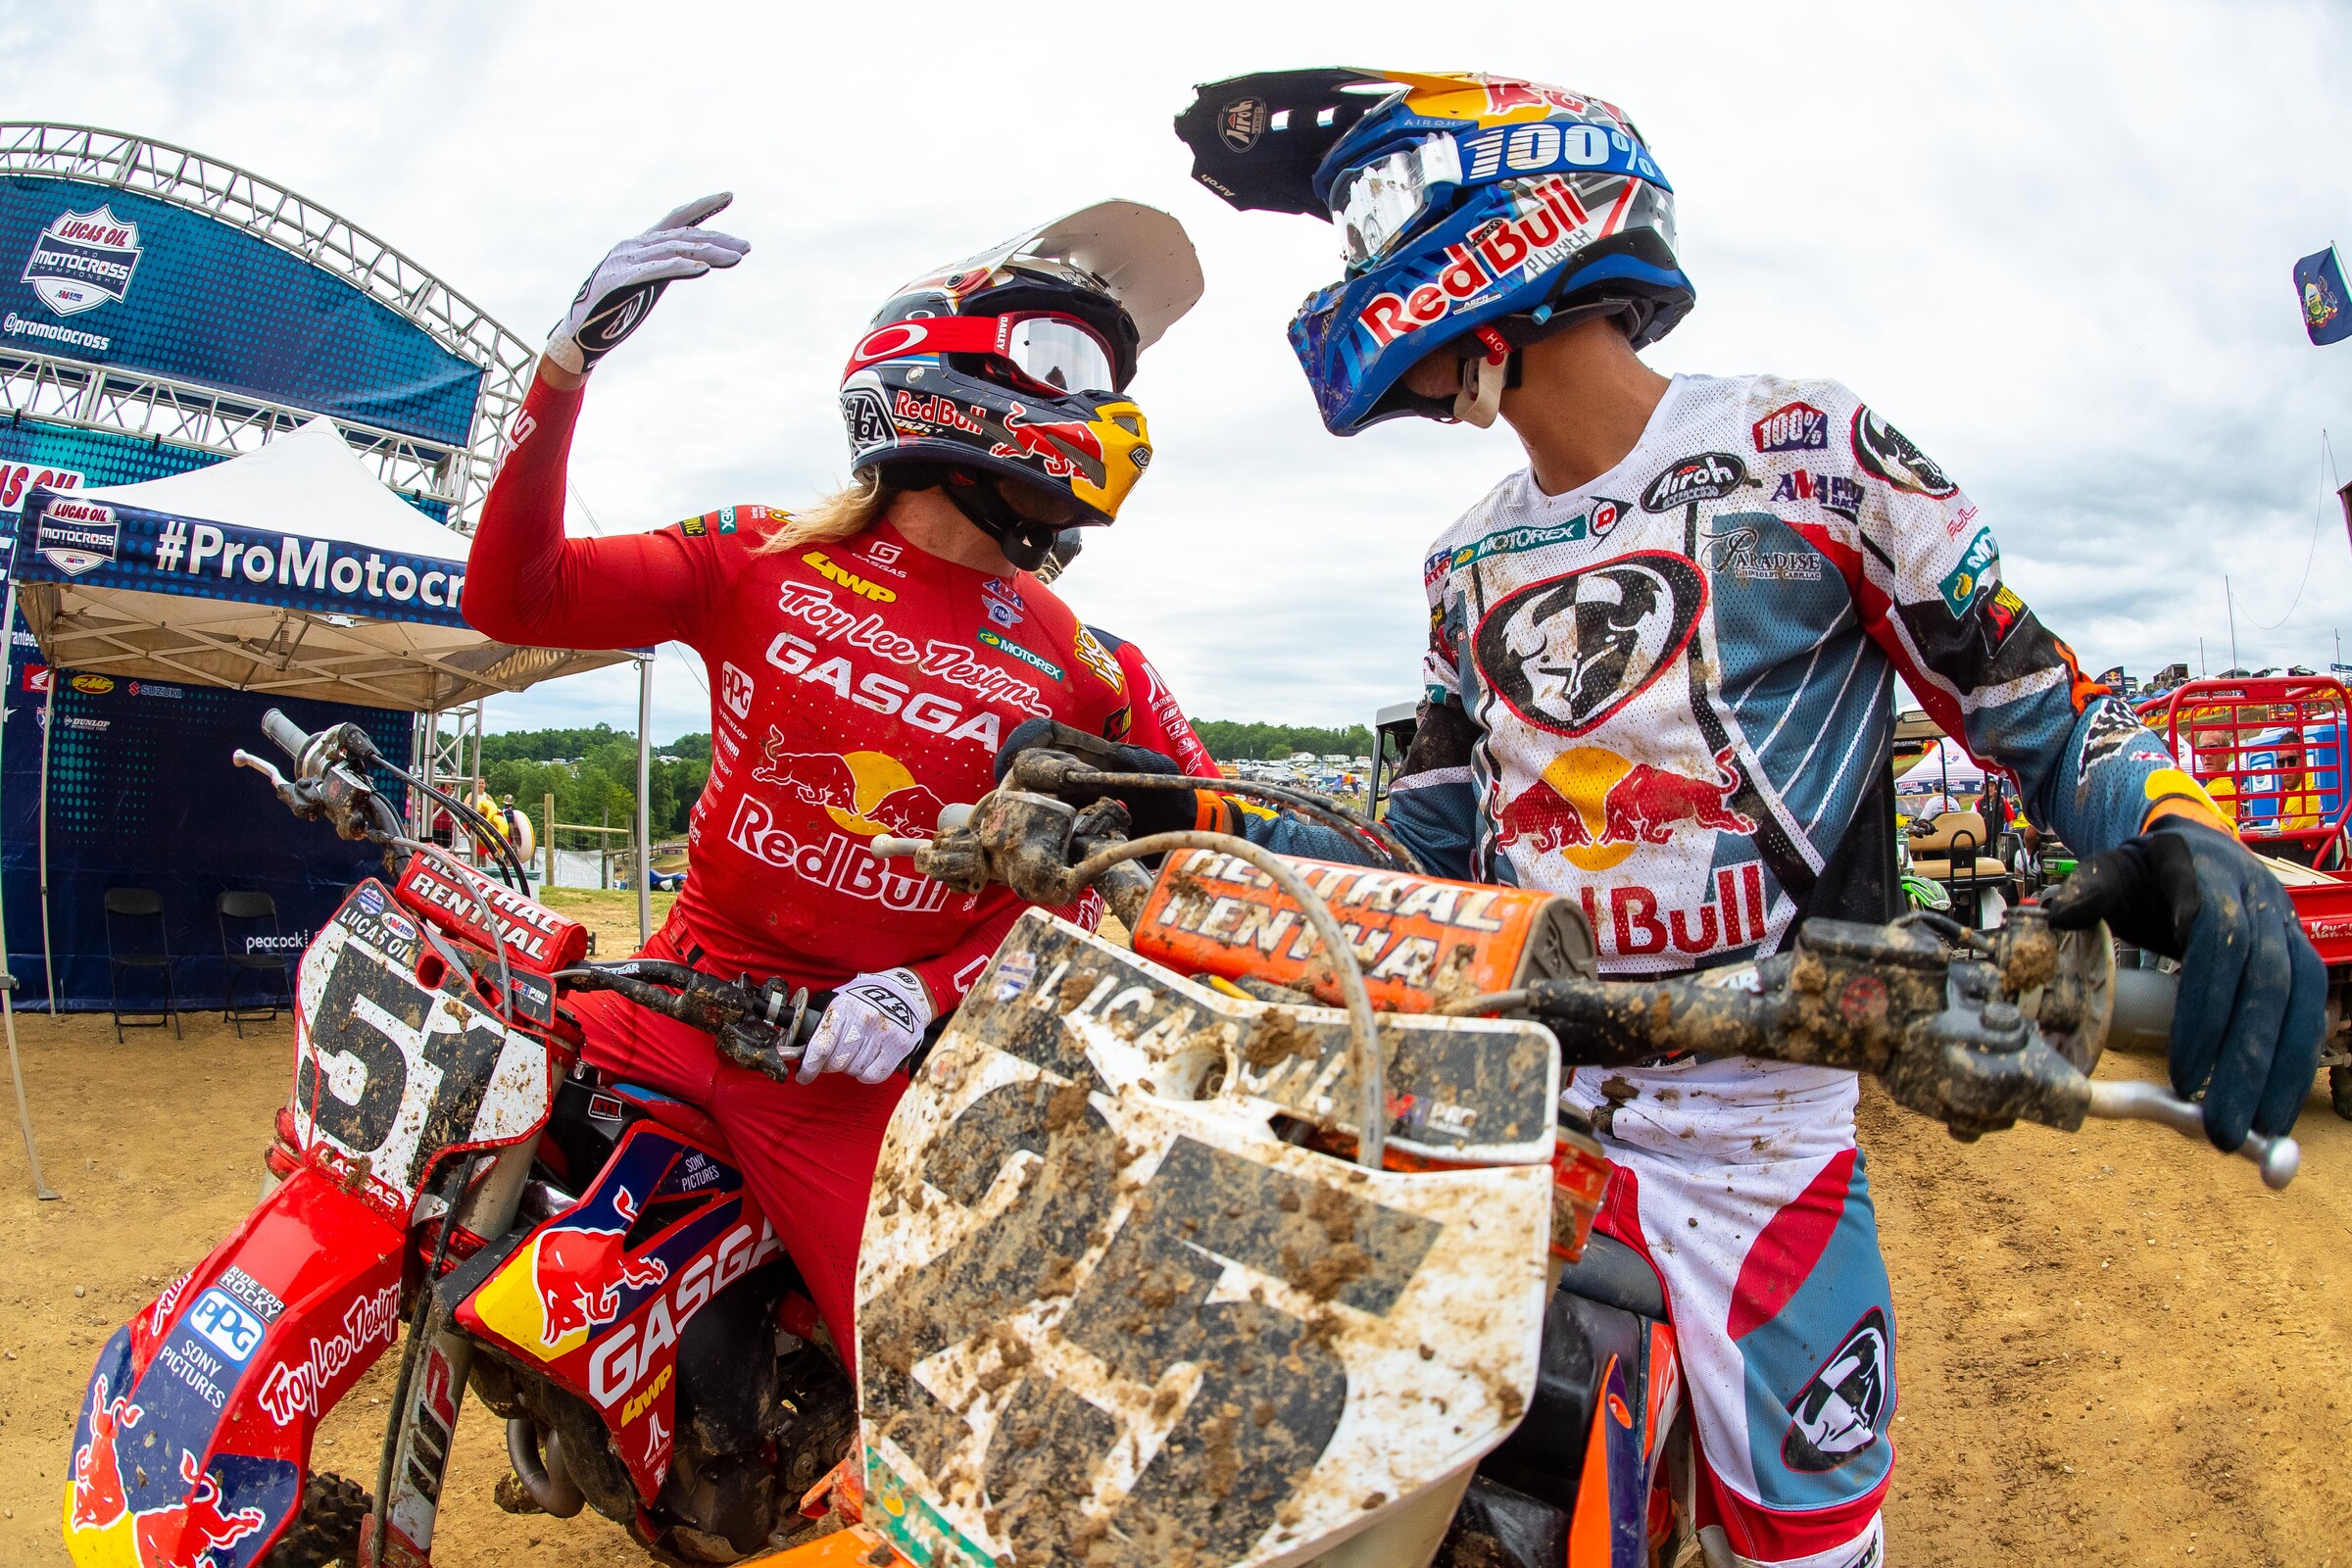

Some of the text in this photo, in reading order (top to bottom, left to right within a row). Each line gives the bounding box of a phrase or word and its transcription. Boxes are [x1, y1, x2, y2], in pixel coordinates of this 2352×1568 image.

[1403, 119, 1457, 127] AIROH
[1463, 123, 1655, 180] 100%
[59, 220, 129, 248] LUCAS OIL
[34, 250, 130, 280] MOTOCROSS
[73, 248, 99, 259] PRO
[1358, 173, 1590, 347] Red Bull
[31, 265, 125, 286] CHAMPIONSHIP
[1348, 305, 1359, 321] YOU
[4, 313, 111, 351] @promotocross
[996, 316, 1008, 351] OAKLEY
[894, 389, 988, 436] Red Bull
[1759, 408, 1823, 450] 100%
[1648, 456, 1735, 508] Airoh
[53, 503, 107, 523] LUCAS OIL
[41, 527, 115, 546] MOTOCROSS
[1477, 522, 1576, 560] MOTOREX
[852, 551, 907, 579] GASGAS
[983, 577, 1024, 612] AMA
[994, 607, 1009, 620] FIM
[778, 580, 858, 641] Troy
[846, 613, 920, 665] Lee
[917, 636, 1054, 720] Designs
[1000, 639, 1061, 680] MOTOREX
[73, 676, 115, 690] FMF
[141, 684, 182, 699] SUZUKI
[722, 668, 752, 712] PPG
[72, 717, 111, 727] DUNLOP
[722, 711, 748, 741] DUNLOP
[727, 793, 952, 914] Red Bull
[339, 906, 389, 946] LUCAS
[408, 871, 553, 961] RENTHAL
[1611, 863, 1767, 957] Bull
[246, 932, 304, 956] peacock
[528, 986, 549, 1004] PRO
[297, 939, 507, 1189] 51
[593, 1098, 619, 1115] ETS
[681, 1164, 720, 1192] PICTURES
[685, 1152, 707, 1173] SONY
[220, 1272, 281, 1318] ROCKY
[228, 1265, 259, 1291] RIDE
[257, 1286, 285, 1311] FOR
[195, 1298, 257, 1354] PPG
[159, 1345, 226, 1409] PICTURES
[181, 1340, 222, 1378] SONY
[258, 1360, 318, 1427] Troy
[308, 1338, 352, 1390] Lee
